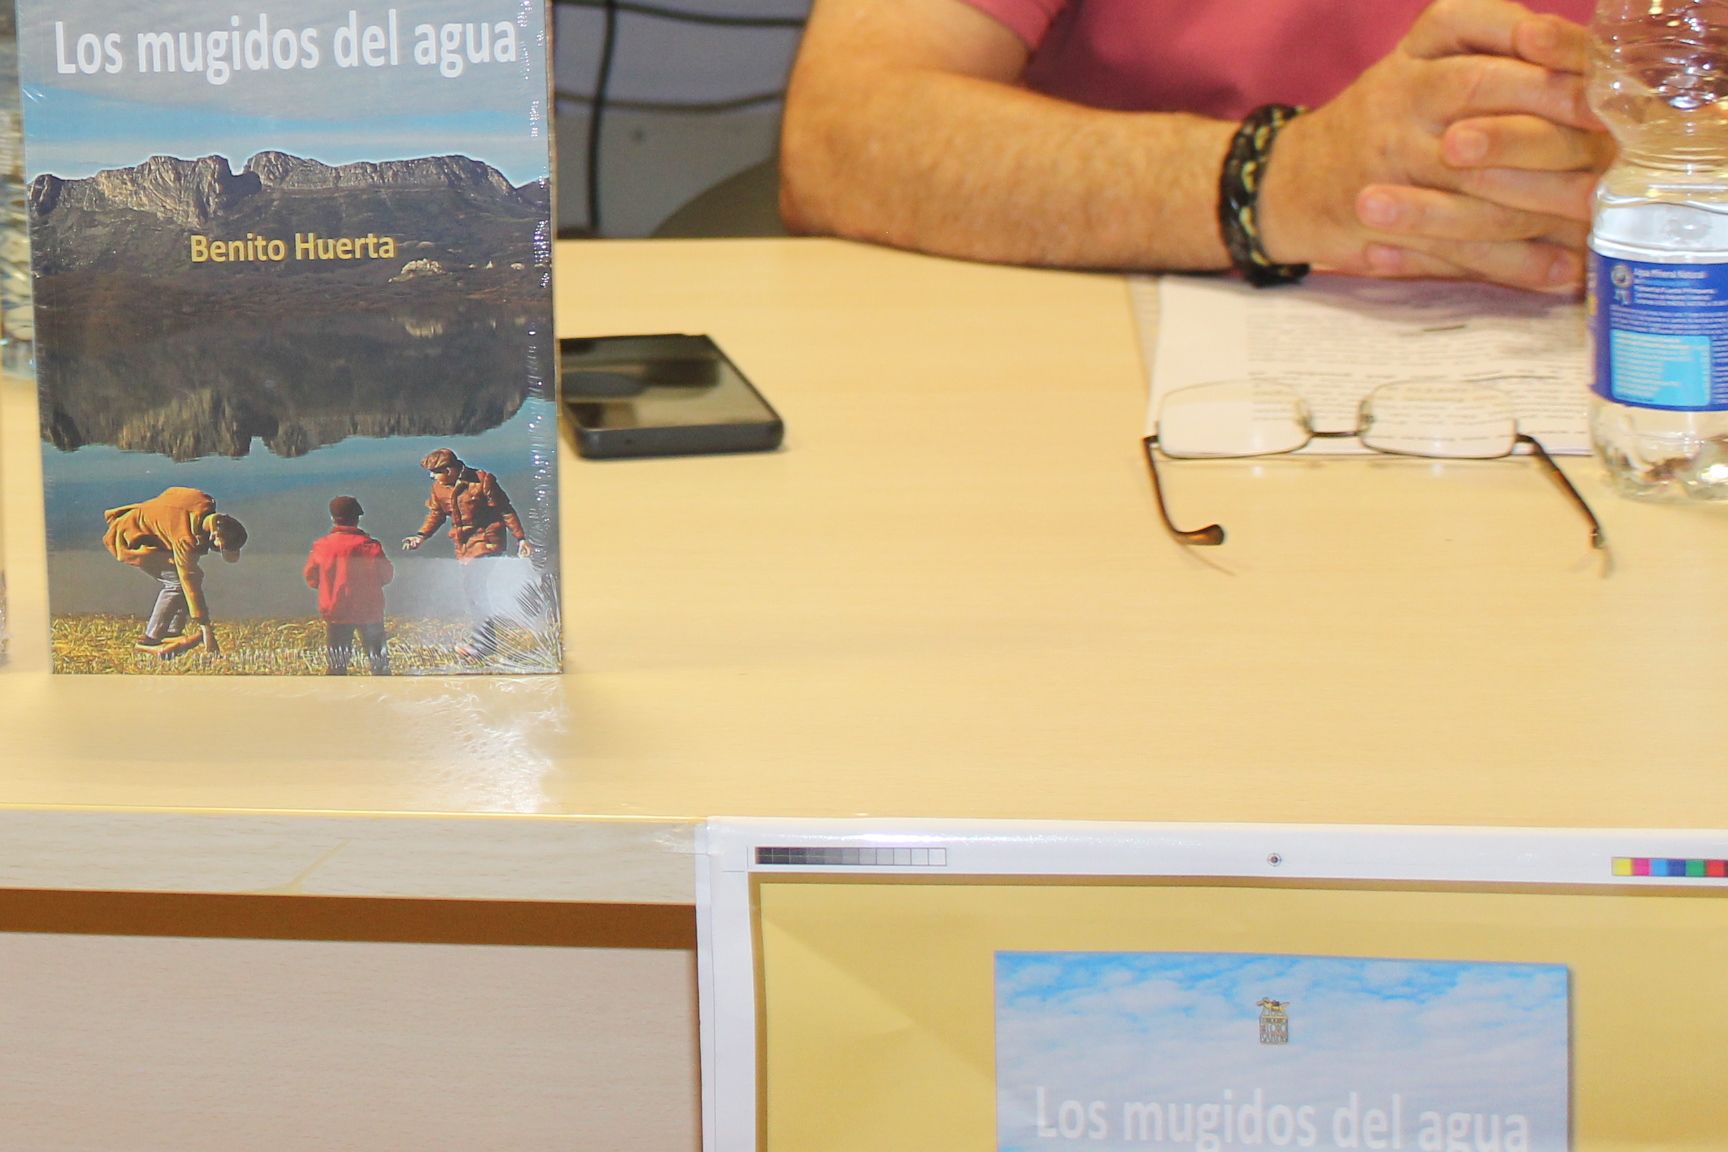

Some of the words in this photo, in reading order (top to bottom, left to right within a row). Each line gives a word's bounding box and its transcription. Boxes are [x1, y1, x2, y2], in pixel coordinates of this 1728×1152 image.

[54, 20, 123, 74] Los
[136, 13, 321, 86] mugidos
[333, 8, 400, 68] del
[413, 18, 518, 79] agua
[189, 232, 287, 263] Benito
[294, 231, 397, 261] Huerta
[1035, 1085, 1107, 1140] Los
[1122, 1087, 1318, 1152] mugidos
[1332, 1091, 1402, 1150] del
[1418, 1109, 1529, 1152] agua
